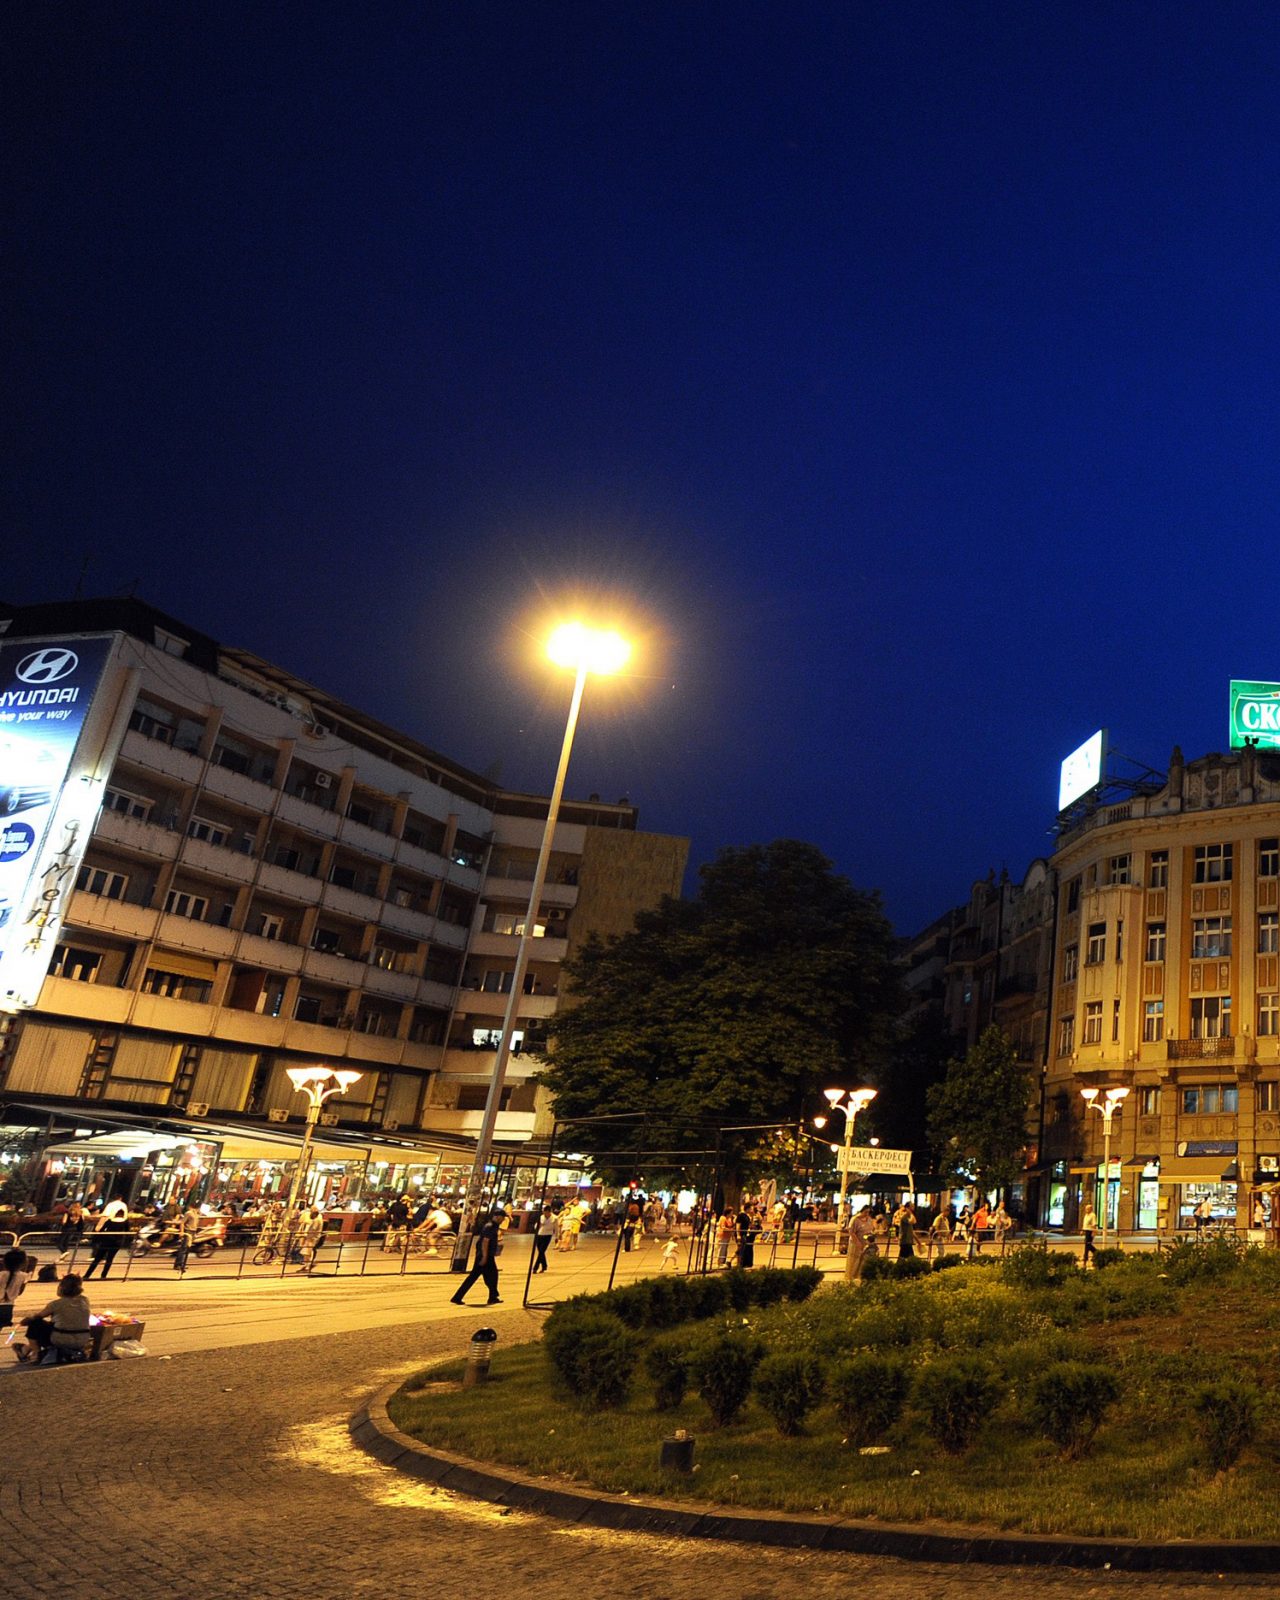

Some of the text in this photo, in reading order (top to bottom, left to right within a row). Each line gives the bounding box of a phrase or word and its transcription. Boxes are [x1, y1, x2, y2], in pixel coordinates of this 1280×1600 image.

[16, 711, 45, 723] your
[46, 710, 72, 721] way
[851, 1149, 909, 1161] БАСКЕРФЕСТ
